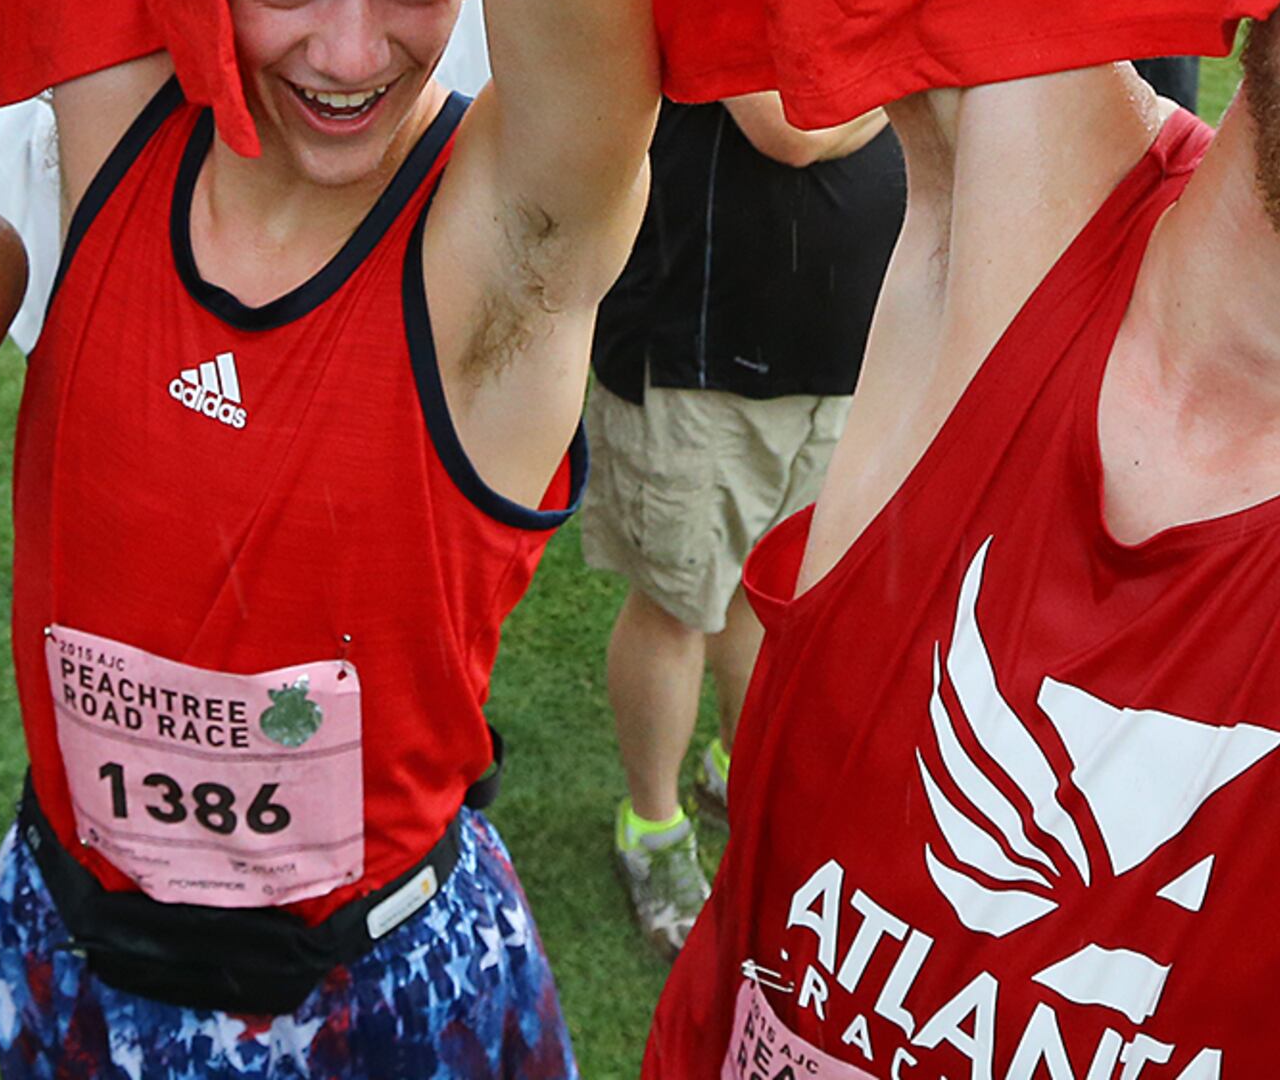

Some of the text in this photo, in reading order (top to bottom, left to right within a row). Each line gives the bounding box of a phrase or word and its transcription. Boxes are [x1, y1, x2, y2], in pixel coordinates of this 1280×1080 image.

[168, 378, 248, 430] adidas
[58, 639, 126, 672] 2015 AJC
[59, 656, 248, 725] PEACHTREE
[62, 684, 251, 749] ROAD RACE
[97, 761, 293, 837] 1386
[779, 1043, 820, 1075] AJC
